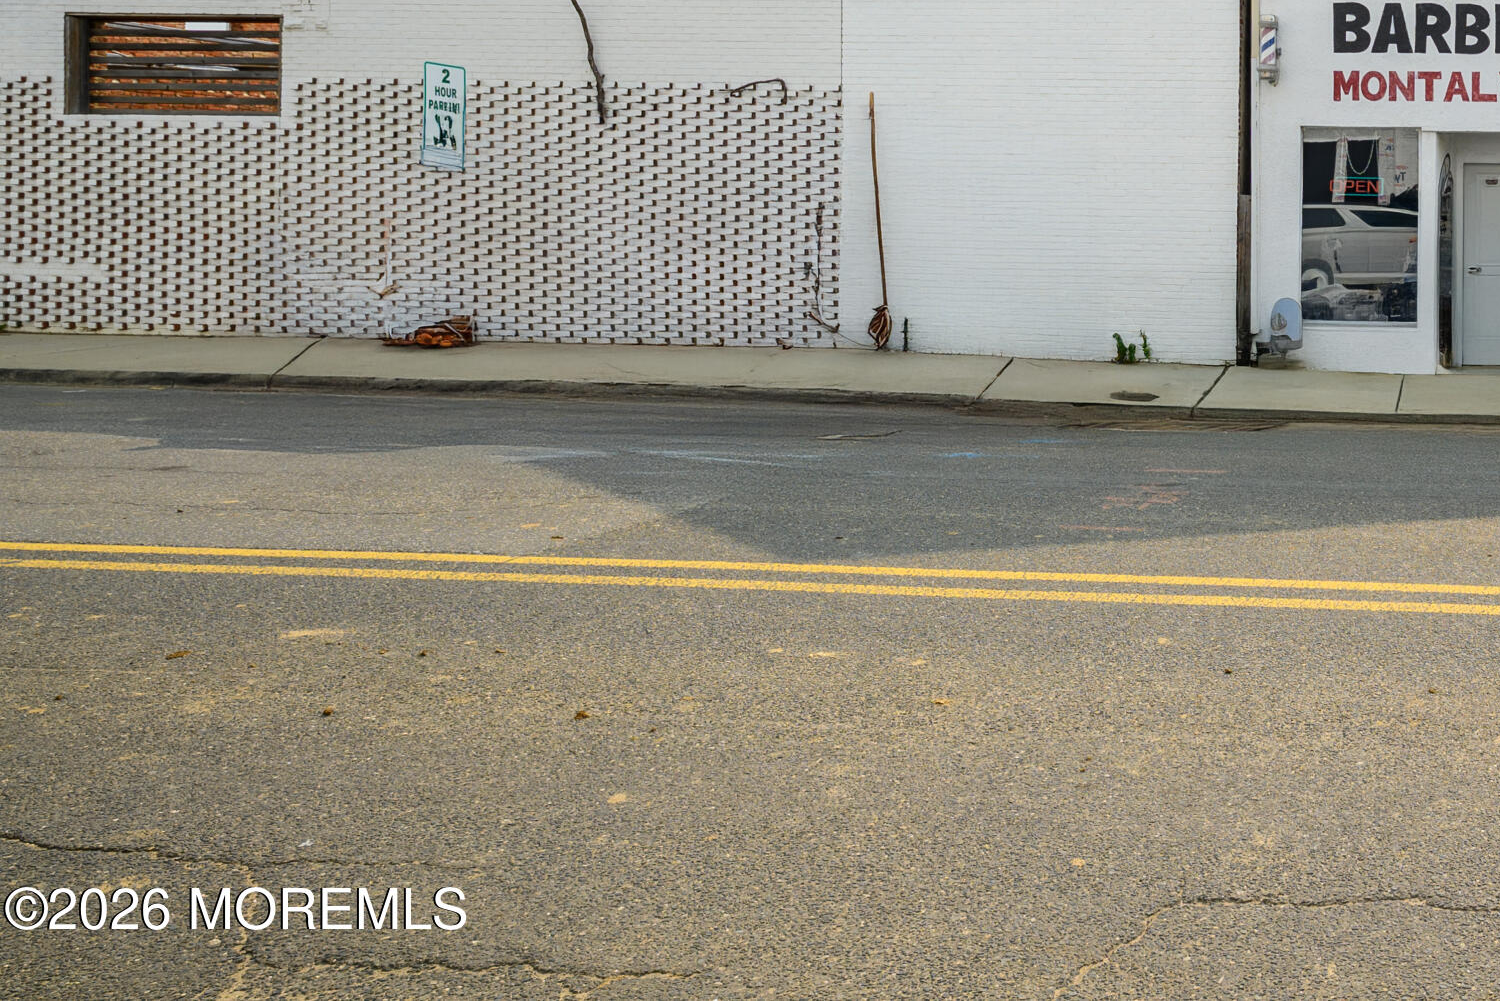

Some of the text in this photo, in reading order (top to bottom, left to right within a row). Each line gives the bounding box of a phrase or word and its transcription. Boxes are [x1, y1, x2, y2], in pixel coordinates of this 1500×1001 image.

[441, 68, 450, 84] 2
[434, 85, 457, 99] HOUR
[1329, 179, 1380, 193] OPEN
